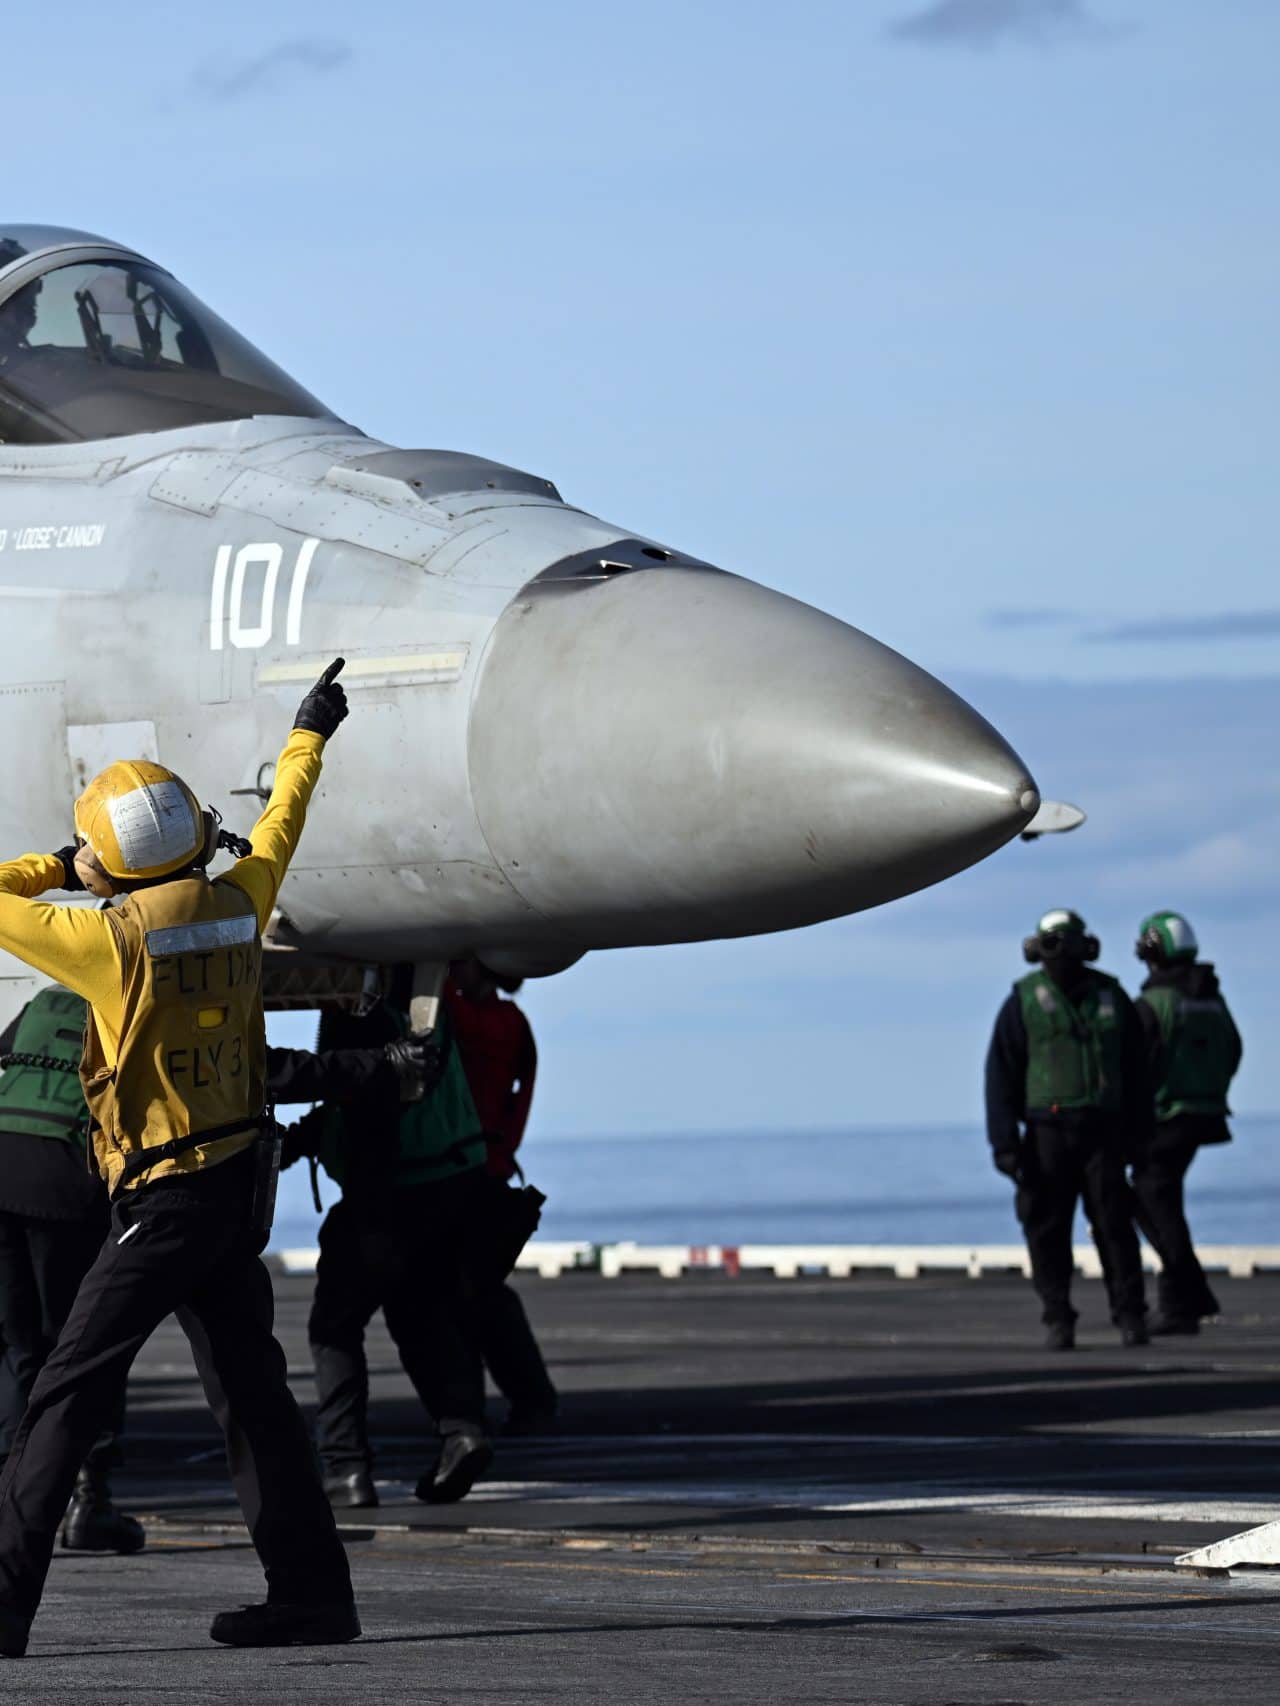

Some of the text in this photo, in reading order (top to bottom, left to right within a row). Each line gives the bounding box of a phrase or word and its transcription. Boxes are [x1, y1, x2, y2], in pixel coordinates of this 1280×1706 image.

[56, 524, 106, 548] CANNON
[210, 538, 320, 650] 101
[152, 952, 214, 997] FLT
[166, 1036, 243, 1090] FLY 3
